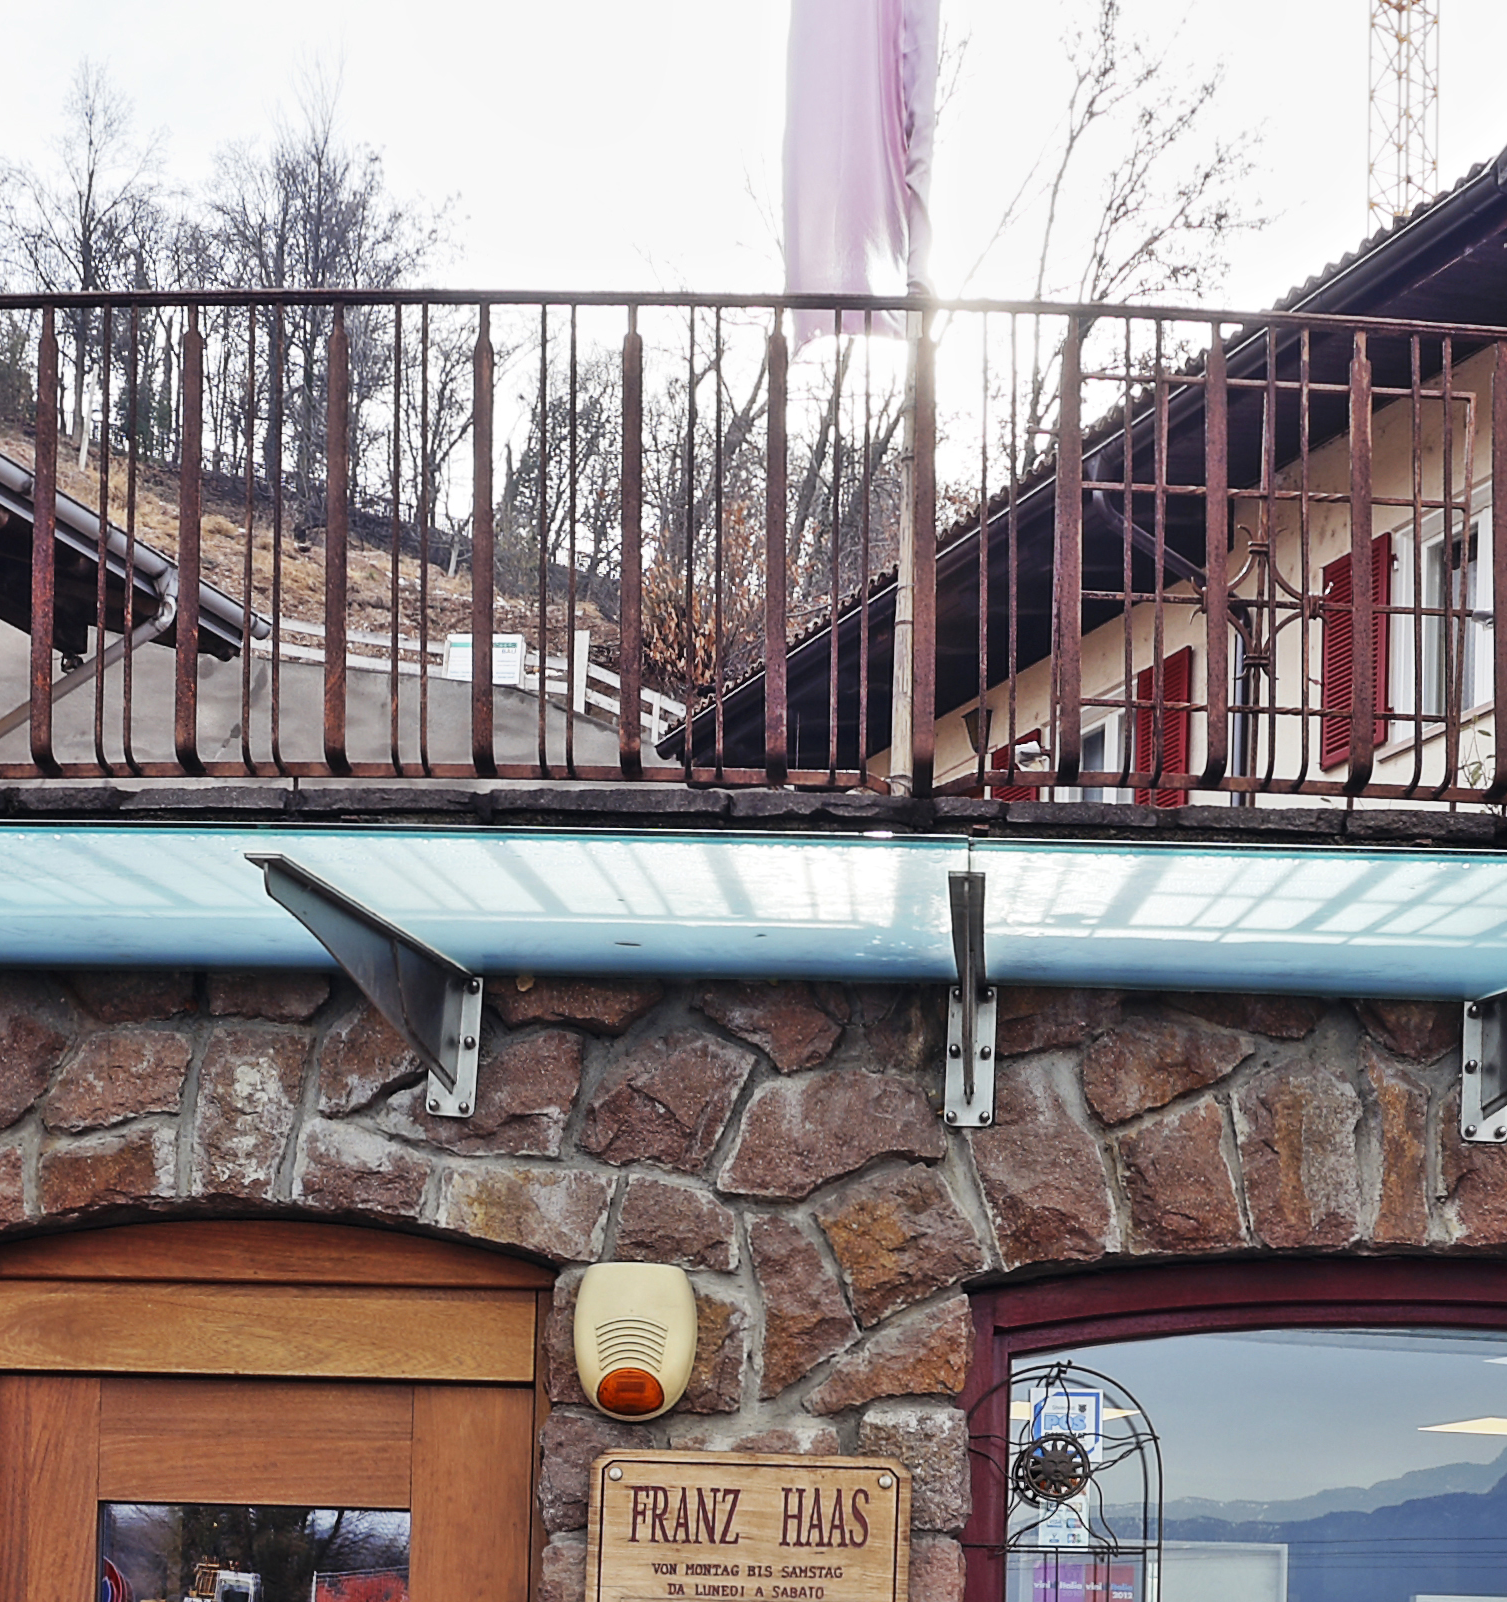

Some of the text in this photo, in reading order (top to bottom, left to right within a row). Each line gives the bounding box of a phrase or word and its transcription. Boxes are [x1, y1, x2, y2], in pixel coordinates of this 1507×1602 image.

[627, 1486, 870, 1548] FRANZ HAAS
[652, 1563, 843, 1579] VON MONTAG BIS SAMSTAG
[668, 1583, 825, 1599] DA LUNEDI A SABATO
